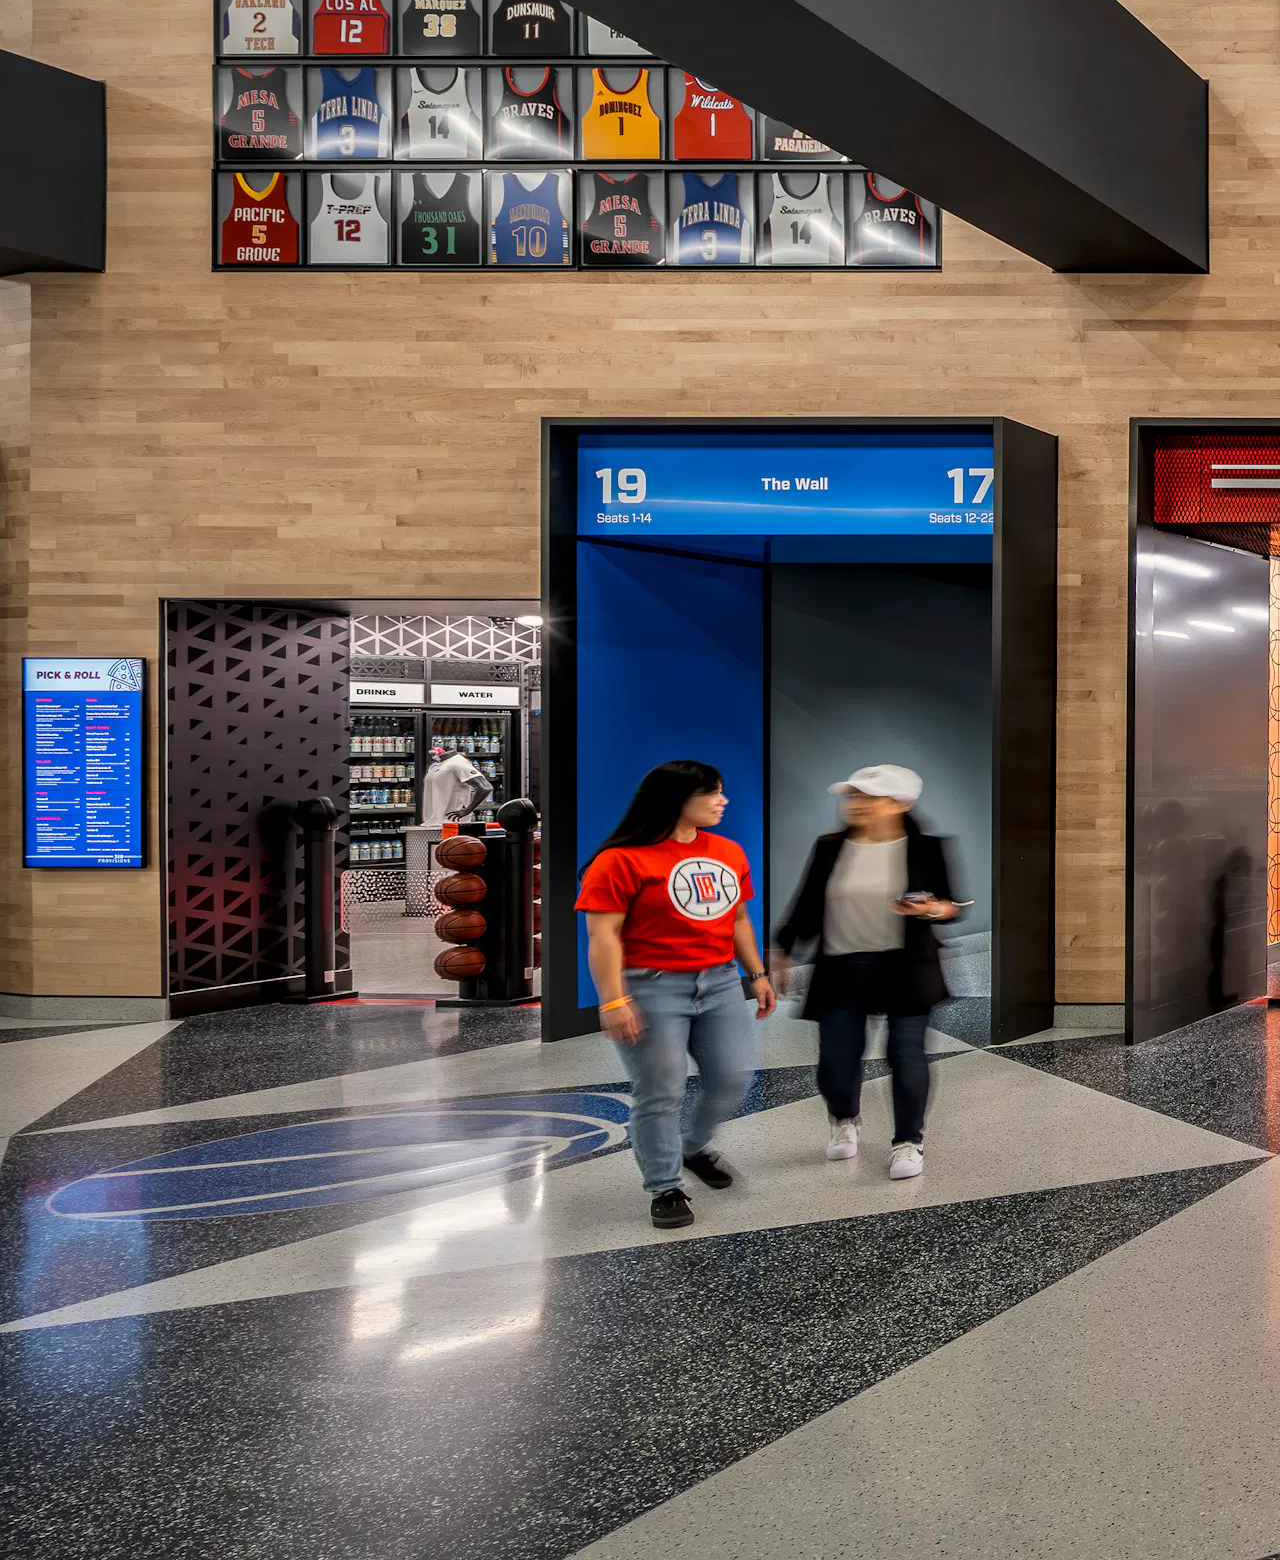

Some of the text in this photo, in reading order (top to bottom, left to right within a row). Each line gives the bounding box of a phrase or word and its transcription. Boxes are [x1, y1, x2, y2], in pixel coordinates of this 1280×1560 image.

[506, 2, 556, 22] DUNSMUIR
[340, 20, 362, 44] 12
[423, 14, 457, 38] 38
[237, 90, 280, 110] MESA
[691, 94, 734, 110] Wildcats
[600, 101, 642, 118] DOMINGUEZ
[228, 134, 288, 150] GRANDE
[234, 209, 285, 224] PACIFIC
[333, 219, 361, 243] 12
[422, 227, 456, 255] 31
[236, 247, 280, 262] GROVE
[595, 468, 647, 504] 19
[761, 477, 828, 491] The Wall
[947, 467, 994, 504] 17
[597, 512, 651, 523] Seats 1-14
[929, 512, 994, 523] Seats 12-22
[37, 671, 100, 679] PICK & ROLL
